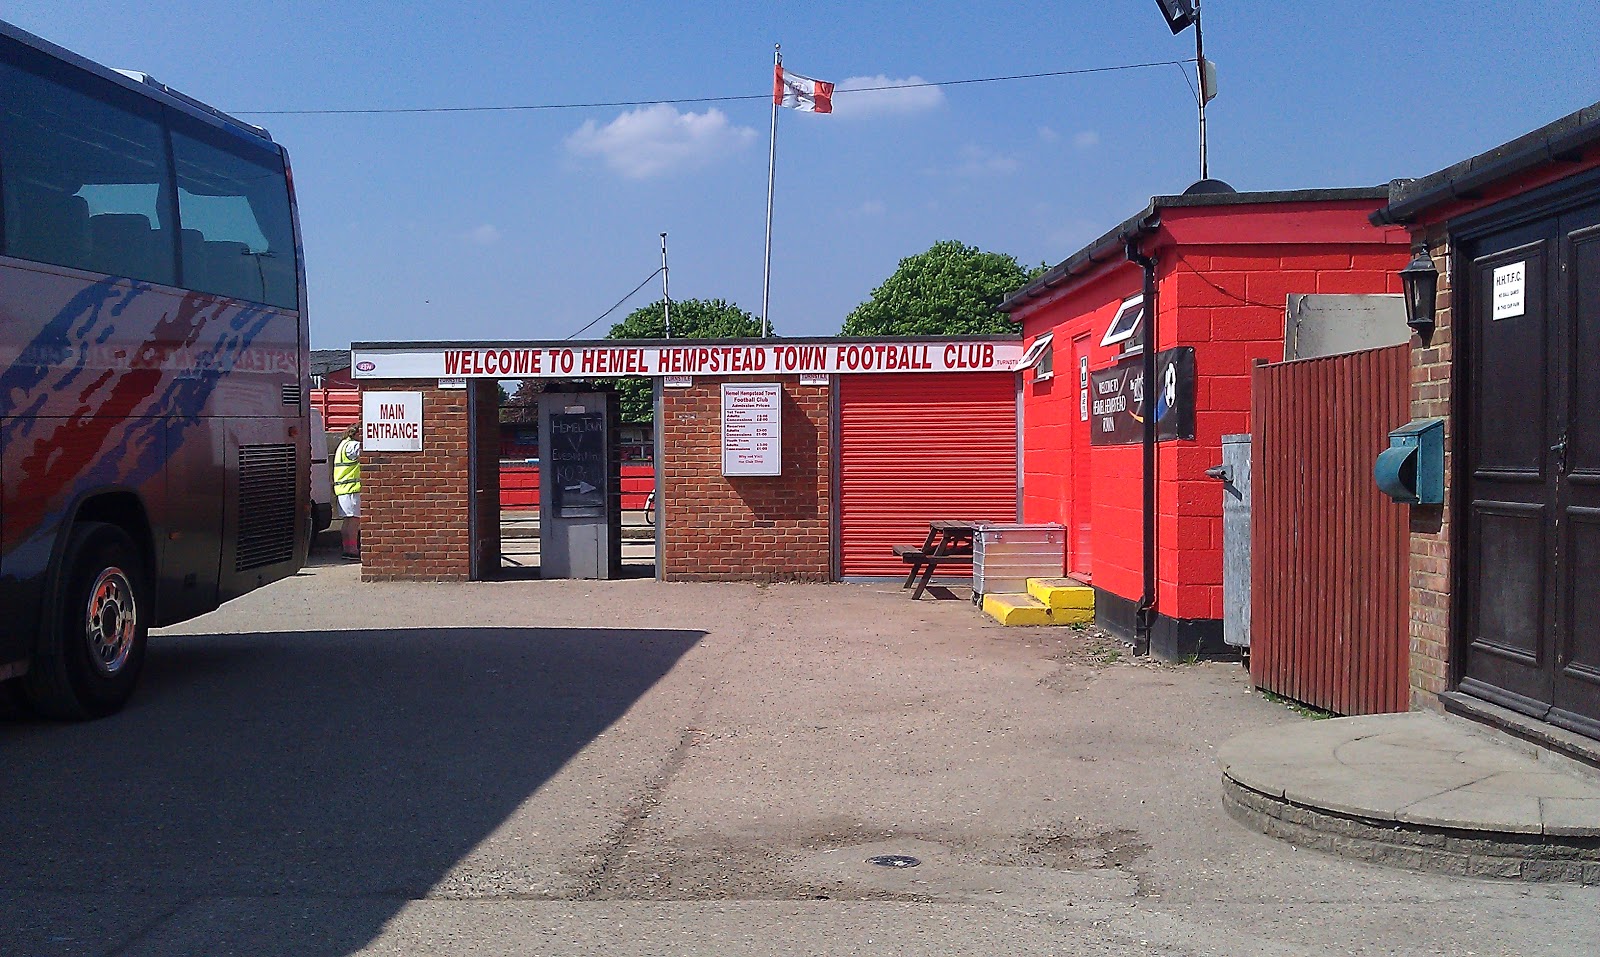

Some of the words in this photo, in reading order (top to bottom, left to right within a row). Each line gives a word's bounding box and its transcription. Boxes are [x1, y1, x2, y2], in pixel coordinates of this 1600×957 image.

[444, 350, 542, 374] WELCOME
[548, 348, 574, 374] TO
[582, 348, 648, 372] HEMEL
[658, 347, 766, 372] HEMPSTEAD
[774, 346, 828, 371] TOWN
[836, 345, 932, 370] FOOTBALL
[943, 344, 994, 369] CLUB
[380, 404, 405, 420] MAIN
[366, 423, 418, 439] ENTRANCE
